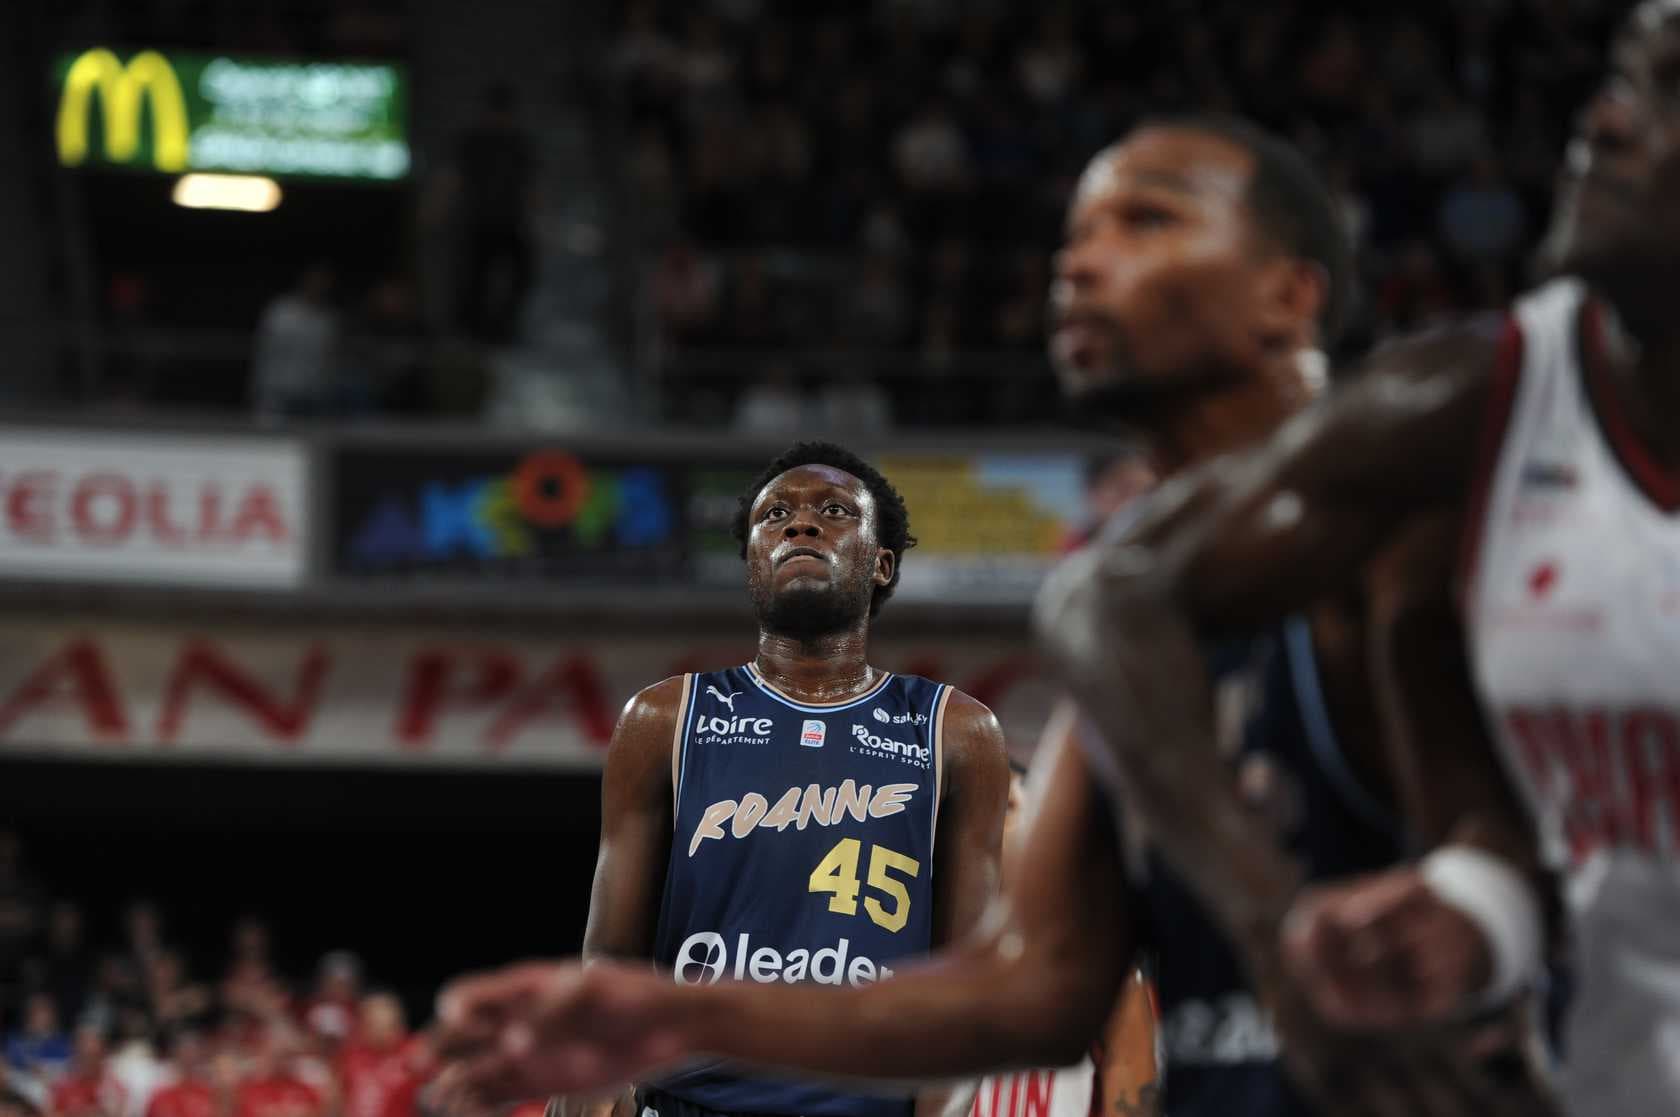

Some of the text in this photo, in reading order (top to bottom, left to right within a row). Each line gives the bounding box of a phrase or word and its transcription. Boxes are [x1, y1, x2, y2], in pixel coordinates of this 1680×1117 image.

[0, 468, 291, 546] EOLIA
[696, 714, 773, 735] Loire
[852, 724, 929, 762] Roanne
[808, 838, 920, 934] 45
